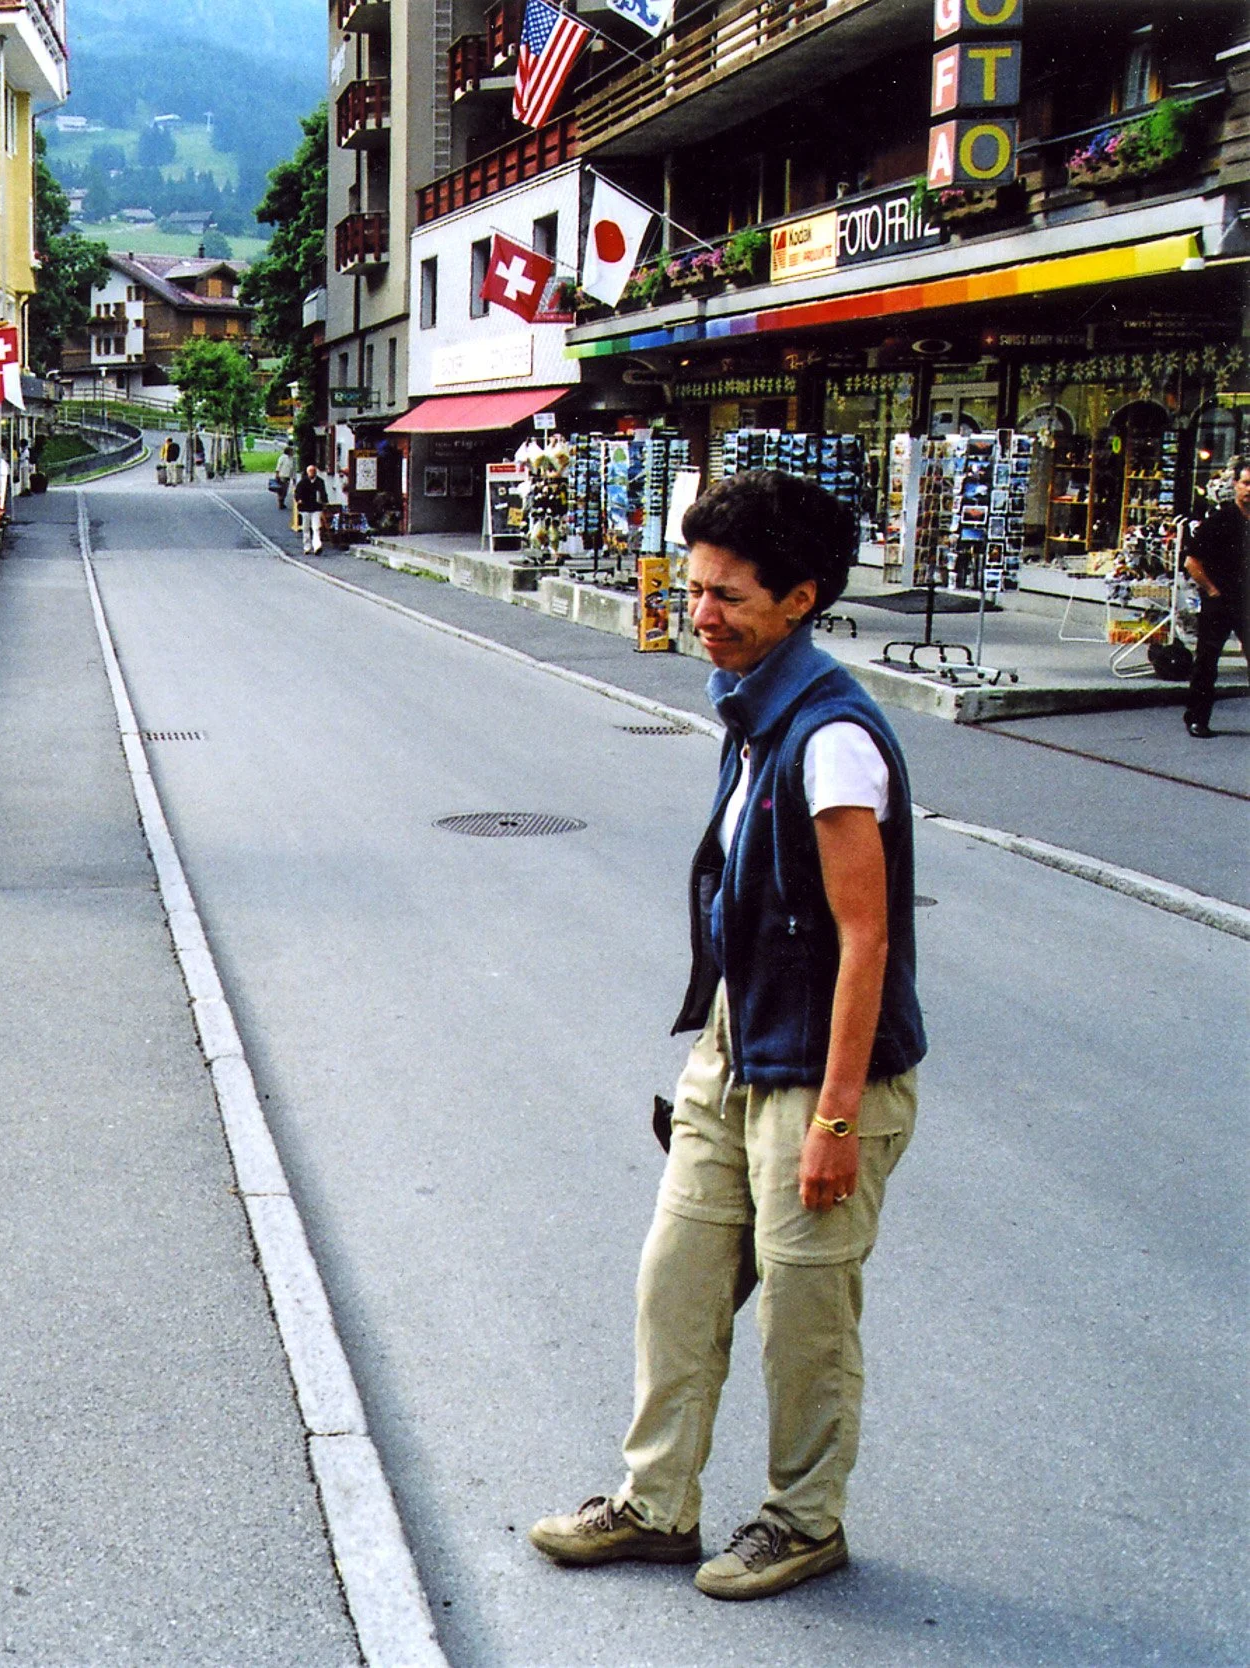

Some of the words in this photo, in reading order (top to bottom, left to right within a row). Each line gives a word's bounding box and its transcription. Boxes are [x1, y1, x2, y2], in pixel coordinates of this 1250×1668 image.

[788, 222, 812, 246] Kodak
[836, 204, 882, 257] FOTO
[999, 334, 1027, 346] SWISS
